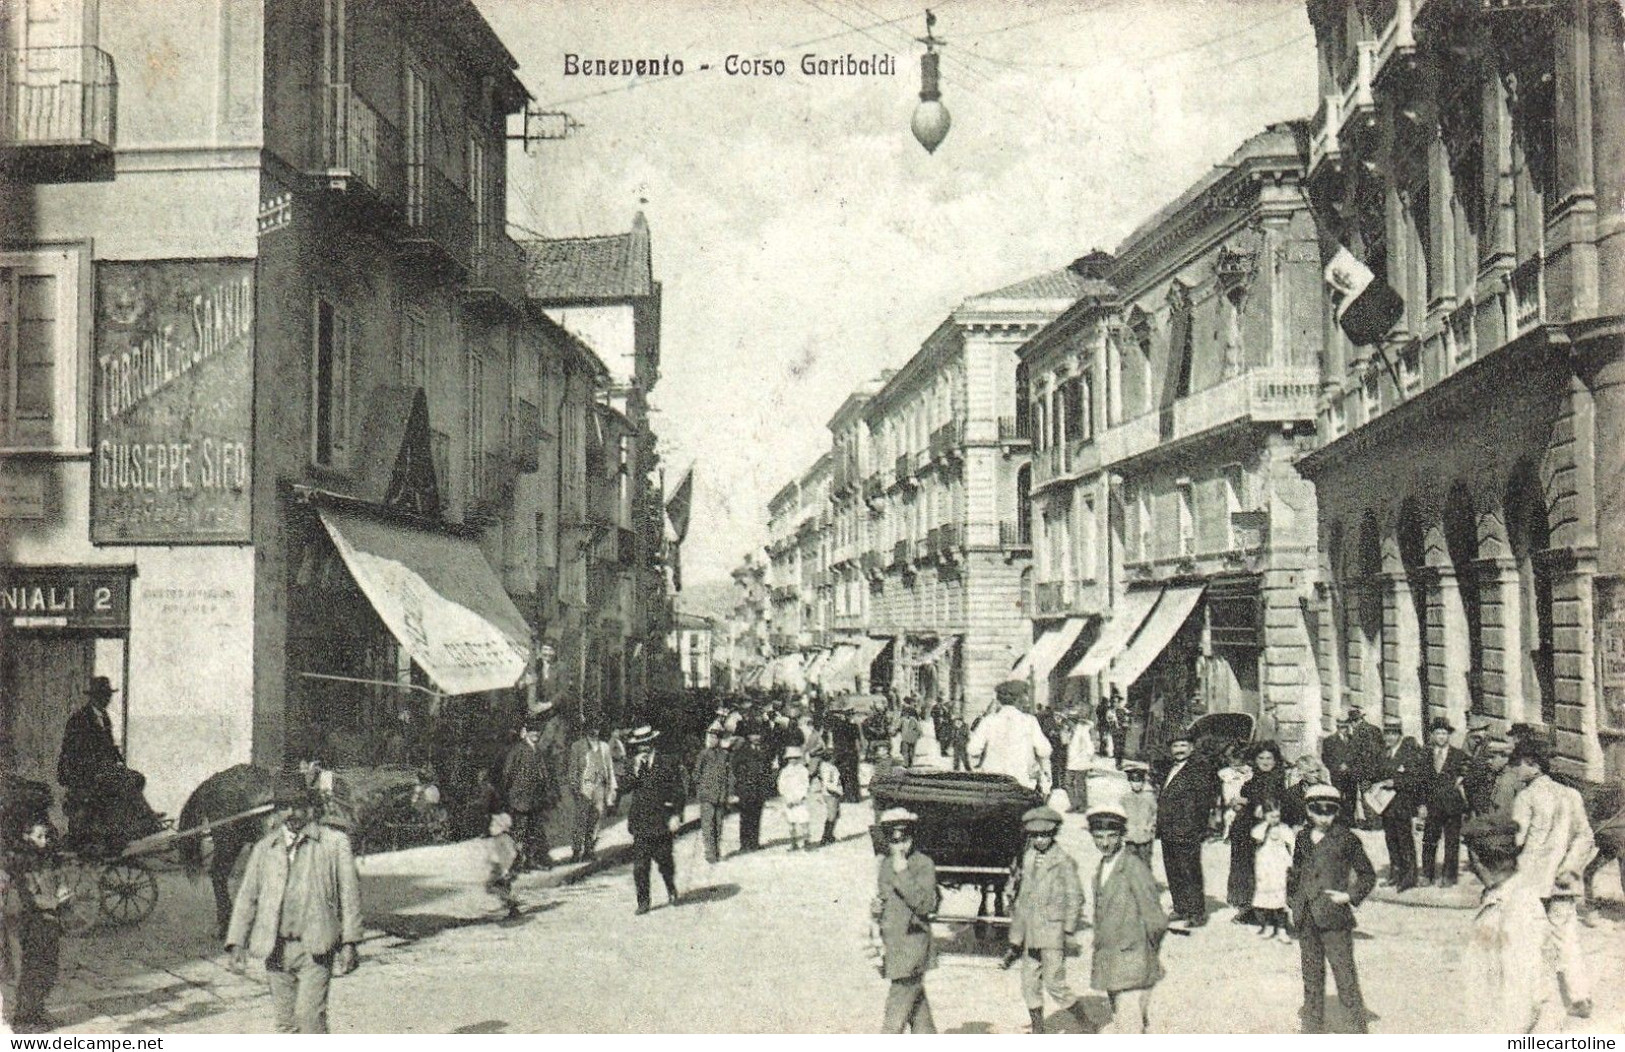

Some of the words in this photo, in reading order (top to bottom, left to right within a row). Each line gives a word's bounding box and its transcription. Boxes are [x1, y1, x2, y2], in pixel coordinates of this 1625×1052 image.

[100, 324, 173, 424] TORRONE
[99, 439, 193, 491] GIUSEPPE
[94, 587, 111, 610] 2
